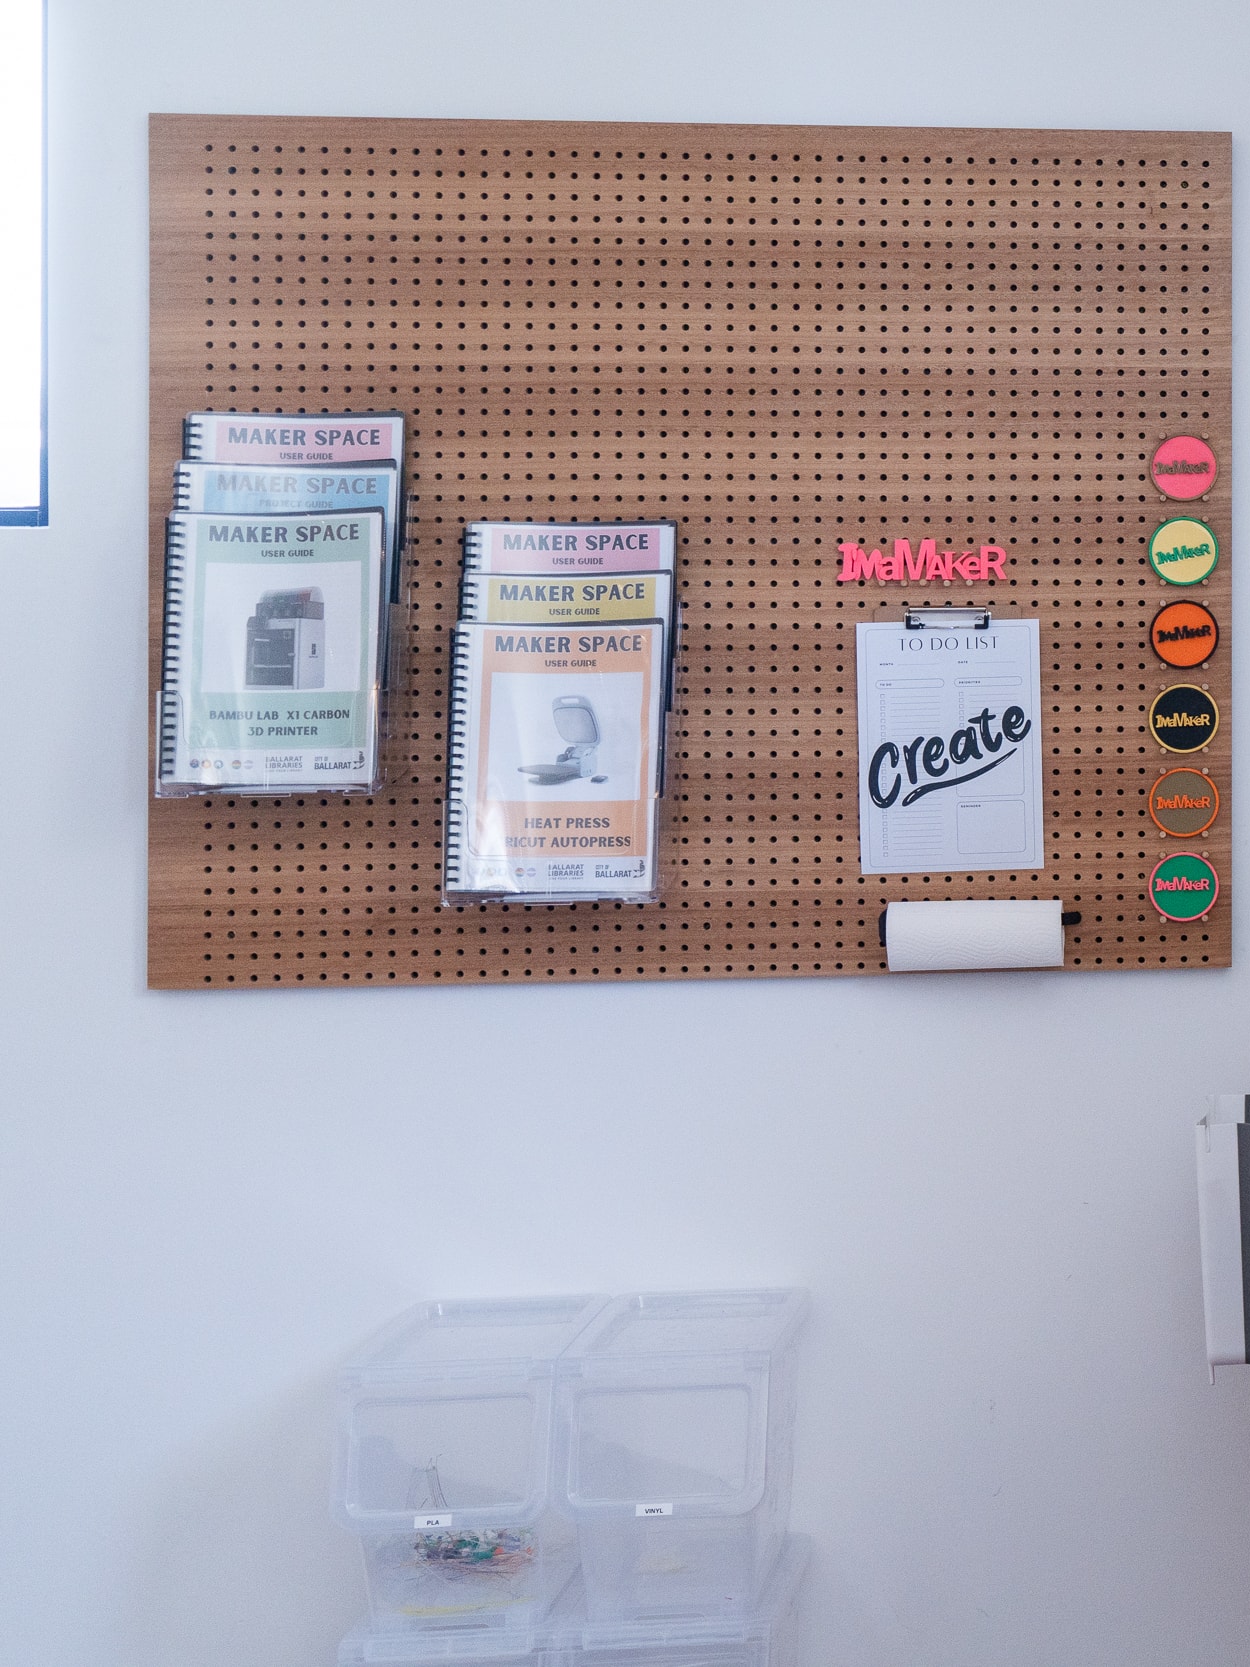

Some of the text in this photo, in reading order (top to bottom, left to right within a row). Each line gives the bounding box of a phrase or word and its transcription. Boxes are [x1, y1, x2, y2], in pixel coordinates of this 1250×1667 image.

[228, 427, 381, 446] MAKER SPACE
[279, 452, 334, 460] USER GUIDE
[217, 474, 377, 494] MAKER SPACE
[305, 500, 334, 509] GUIDE
[209, 523, 360, 543] MAKER SPACE
[503, 533, 649, 551] MAKER SPACE
[261, 549, 315, 558] USER GUIDE
[552, 557, 604, 565] USER GUIDE
[500, 583, 645, 602] MAKER SPACE
[549, 607, 600, 616] USER GUIDE
[495, 635, 642, 653] MAKER SPACE
[897, 635, 999, 652] TO DO LIST
[545, 659, 597, 667] USER GUIDE
[209, 710, 253, 720] BAMBU
[257, 710, 279, 720] LAB
[303, 709, 350, 720] CARBON
[248, 726, 318, 736] 3D PRINTER
[868, 705, 1032, 809] Create
[314, 761, 352, 770] BALLARAT
[524, 817, 610, 829] HEAT PRESS
[551, 836, 631, 848] AUTOPRESS
[595, 870, 632, 878] BALLARAT
